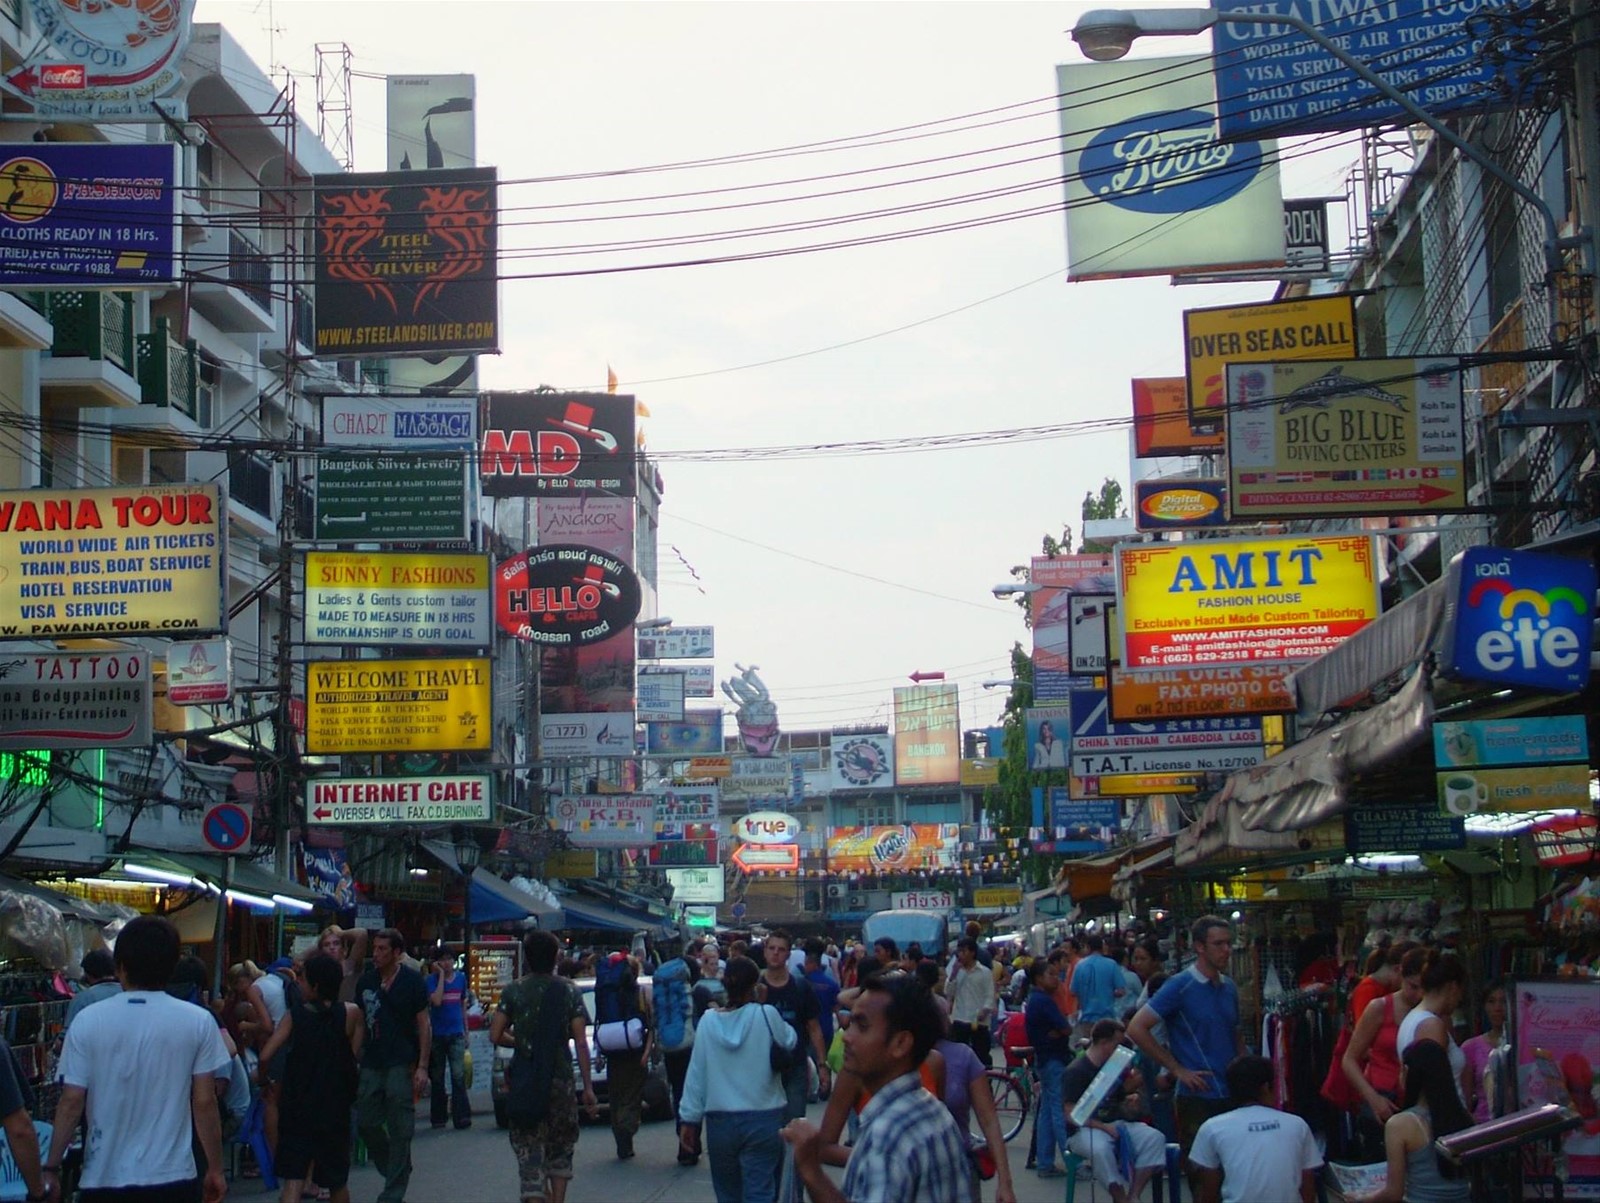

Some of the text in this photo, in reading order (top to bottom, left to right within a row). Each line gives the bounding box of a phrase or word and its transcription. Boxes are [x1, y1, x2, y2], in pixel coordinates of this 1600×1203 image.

[1359, 31, 1389, 48] AIR
[57, 31, 127, 67] FOOD
[1245, 65, 1285, 80] VISA
[1247, 83, 1296, 101] DAILY
[1250, 103, 1299, 122] DAILY
[1100, 126, 1234, 195] Boots
[63, 178, 164, 200] FASHION
[1, 227, 159, 241] CLOTHS READY IN 18 Hrs.
[379, 234, 432, 248] STEEL
[388, 249, 422, 260] AND
[85, 263, 114, 275] 1988.
[372, 261, 438, 275] SILVER
[318, 322, 494, 347] WWW.STEELANDSILVER.COM
[1191, 321, 1350, 358] OVER SEAS CALL
[1421, 401, 1438, 410] Koh
[333, 412, 470, 437] CHART MASSAGE
[1286, 409, 1406, 444] BIG BLUE
[1422, 429, 1440, 439] Koh
[480, 430, 581, 476] MD
[1287, 442, 1406, 462] DIVING CENTERS
[1423, 445, 1457, 454] Similan
[320, 458, 374, 473] Bangkok
[414, 457, 462, 472] Jewelry
[403, 480, 424, 488] MADE
[426, 480, 436, 488] TO
[437, 479, 463, 488] ORDER
[1158, 503, 1205, 512] Services
[1162, 493, 1201, 506] Digital
[112, 494, 214, 527] TOUR
[544, 512, 624, 533] ANGKOR
[20, 533, 215, 555] WORLD WIDE AIR TICKETS
[150, 554, 212, 570] SERVICE
[1168, 548, 1323, 593] AMIT
[321, 566, 476, 584] SUNNY FASHIONS
[20, 578, 172, 597] HOTEL RESERVATION
[318, 593, 477, 607] Ladies & Gents custom tailor
[508, 584, 602, 613] HELLO
[1198, 592, 1302, 609] FASHION HOUSE
[20, 602, 127, 619] VISA SERVICE
[318, 611, 475, 623] MADE TO MEASURE IN 18 HRS
[1134, 606, 1365, 629] Exclusive Hand Made Custom Tailoring
[317, 626, 440, 639] WORKMANSHIP IS OUR
[518, 621, 610, 642] Khoasan road
[1171, 625, 1329, 643] WWW.AMITFASHION.COM
[1151, 634, 1351, 654] E-mail: amitfashion@hotmail.com
[1138, 648, 1281, 665] Tel: (662) 629-2518 Fax:
[35, 656, 141, 680] TATTOO
[317, 668, 485, 689] WELCOME TRAVEL
[33, 687, 141, 703] Bodypainting
[317, 690, 447, 703] AUTHORIZED TRAVEL AGENT
[1201, 681, 1262, 696] PHOTO
[375, 705, 391, 713] AIR
[395, 704, 430, 712] TICKETS
[1228, 697, 1245, 710] 24
[556, 726, 585, 736] 1771
[1486, 731, 1581, 748] homemade
[1078, 731, 1257, 749] CHINA VIETNAM CAMBODIA LAOS
[907, 743, 946, 757] BANGKOK
[1081, 755, 1257, 774] T.A.T. License No. 12/700
[315, 781, 482, 804] INTERNET CAFE
[1496, 784, 1531, 797] fresh
[334, 807, 375, 820] OVERSEA
[745, 818, 786, 834] true
